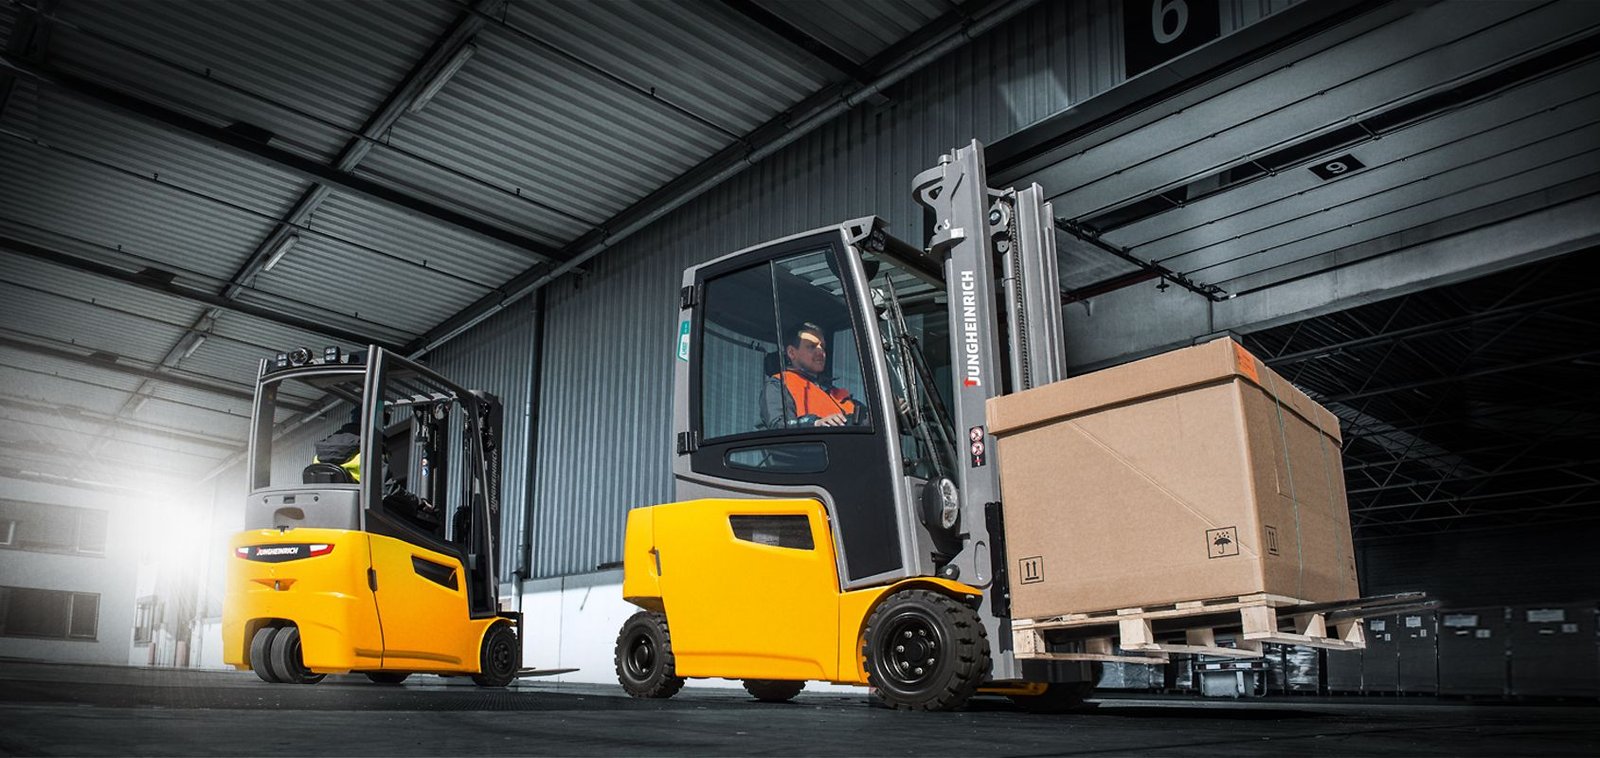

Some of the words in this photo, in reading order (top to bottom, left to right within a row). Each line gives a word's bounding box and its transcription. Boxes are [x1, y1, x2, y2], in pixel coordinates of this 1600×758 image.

[1152, 0, 1189, 44] 6
[961, 270, 981, 387] JUNGHEINRICH
[256, 547, 299, 556] JUNGHEINRICH
